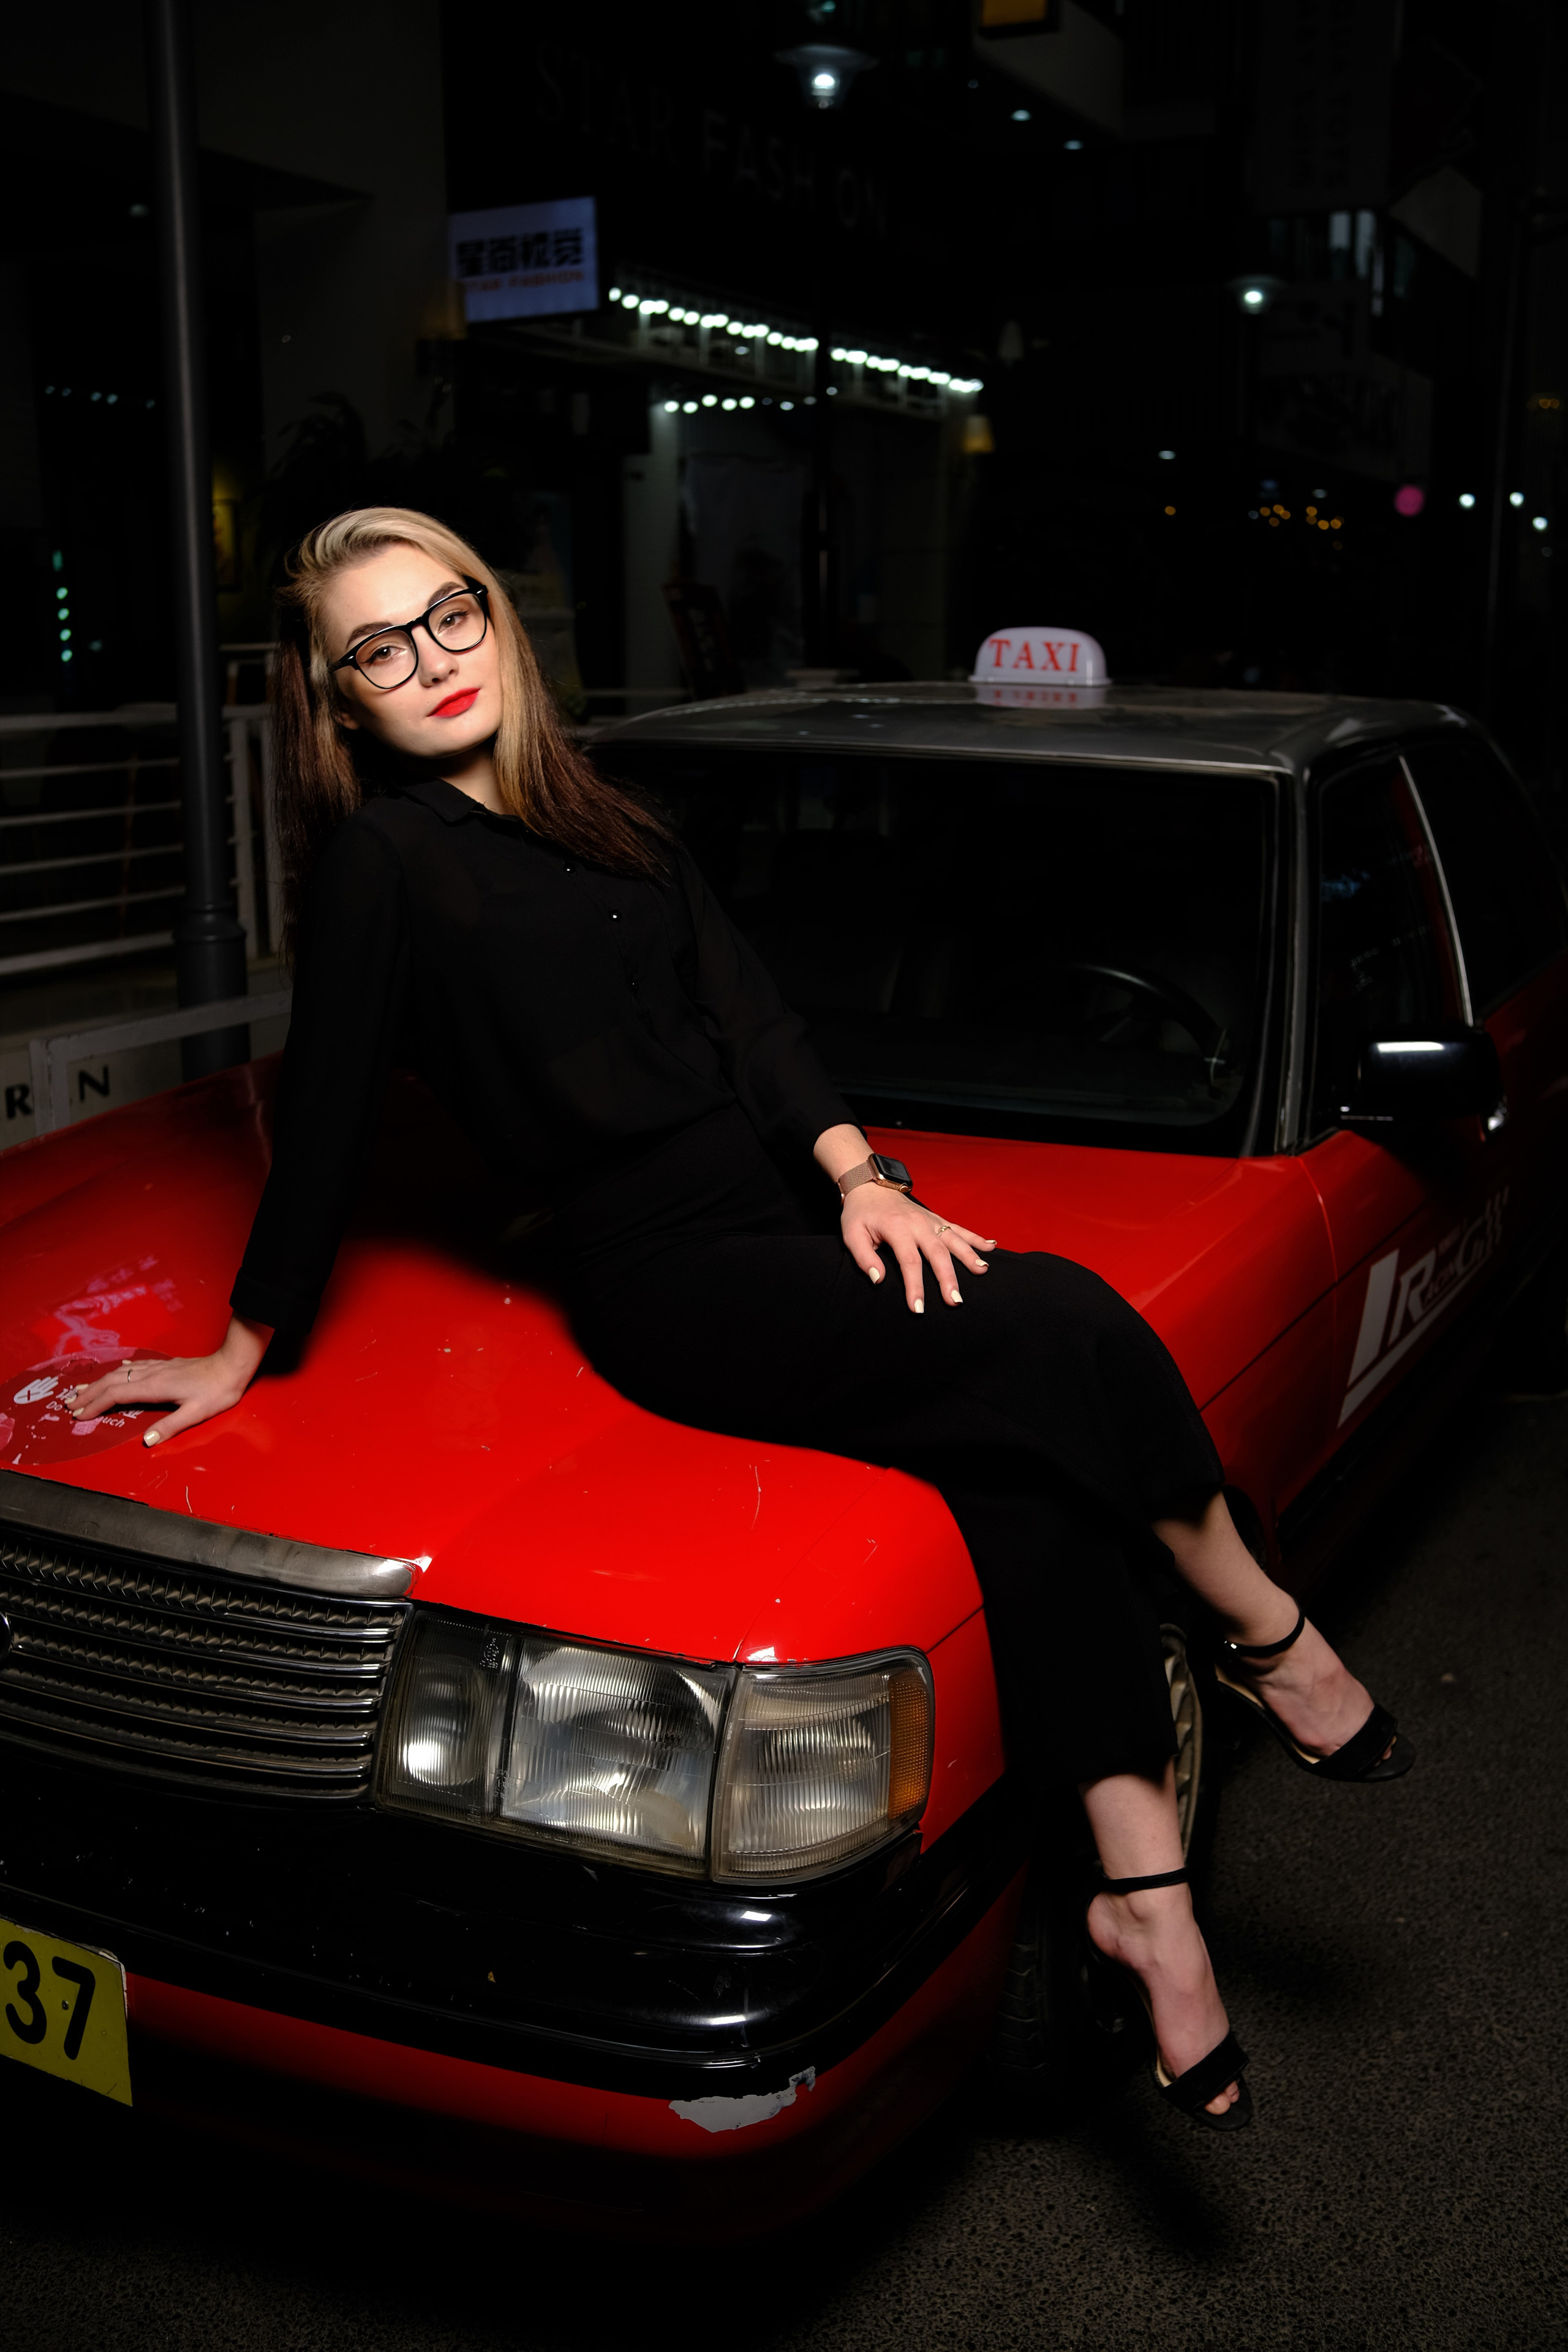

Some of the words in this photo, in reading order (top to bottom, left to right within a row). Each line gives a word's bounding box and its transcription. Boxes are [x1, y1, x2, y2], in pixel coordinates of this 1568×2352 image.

[535, 40, 680, 167] STAR
[703, 105, 889, 241] FASHON
[989, 639, 1085, 672] TAXI
[3, 1940, 96, 2060] 37
